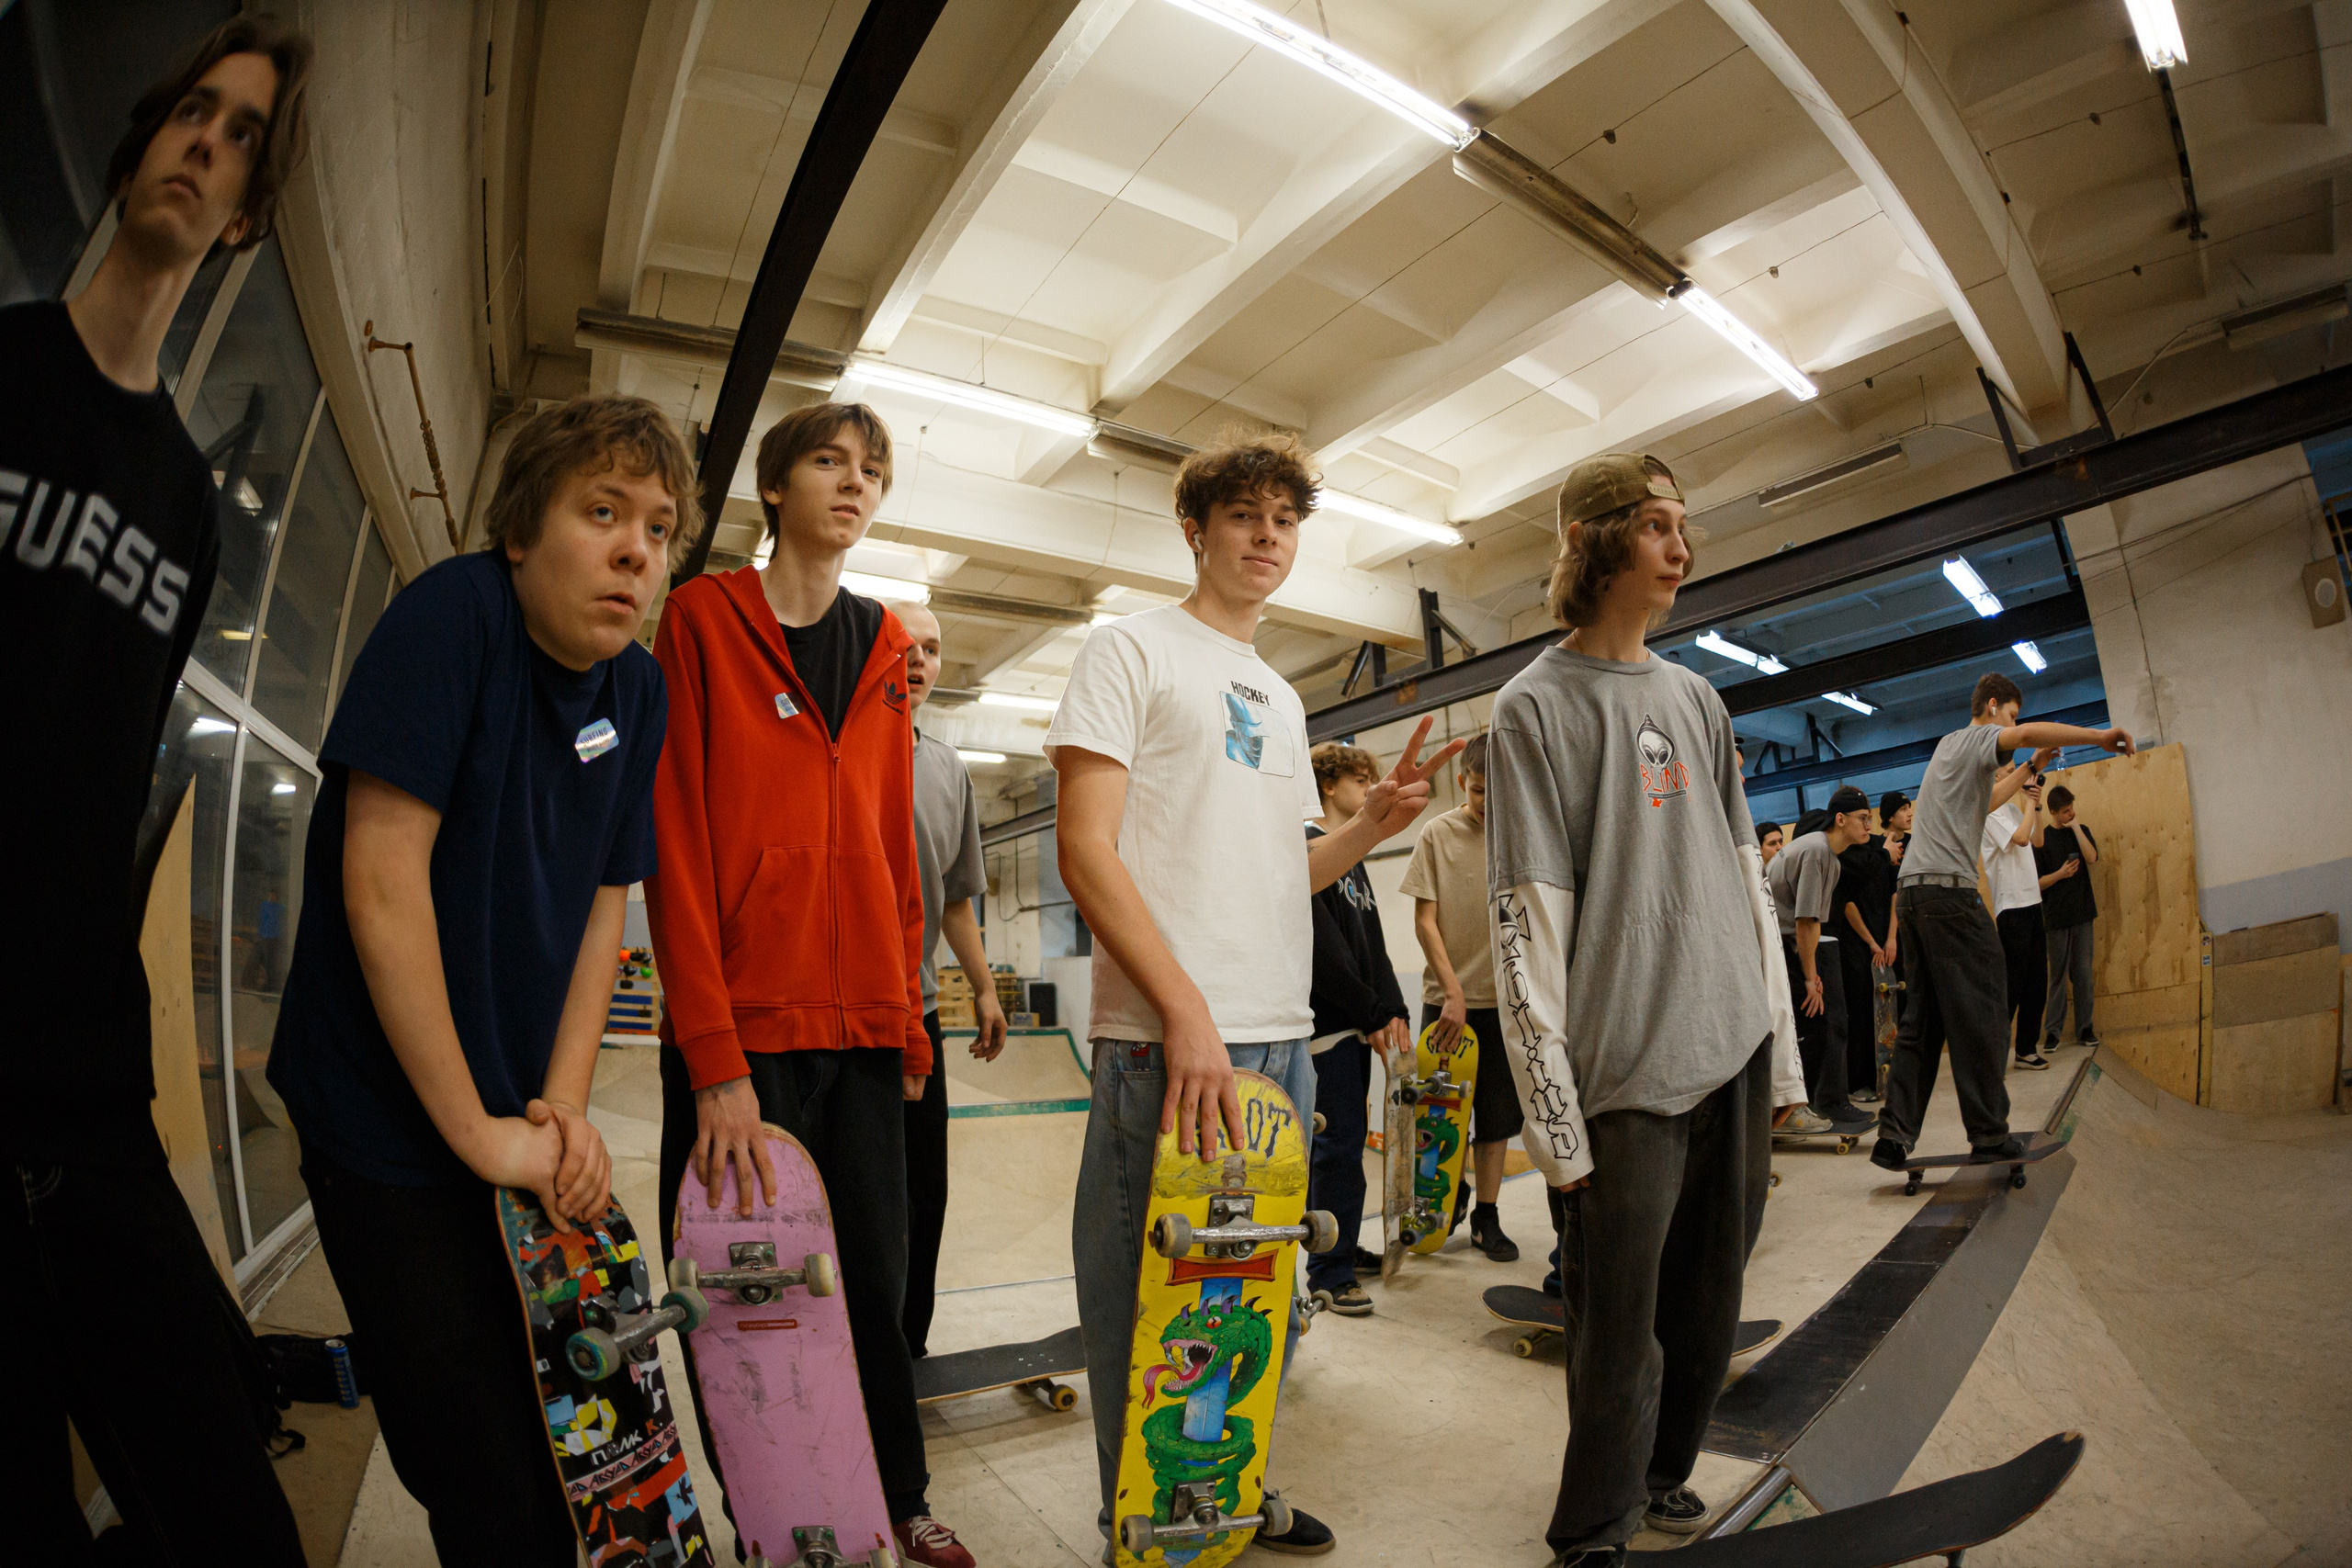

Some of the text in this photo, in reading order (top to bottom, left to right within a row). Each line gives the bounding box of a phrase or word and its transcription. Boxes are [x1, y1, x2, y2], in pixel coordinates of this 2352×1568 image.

[1230, 680, 1271, 706] HOCKEY
[580, 726, 609, 744] SURFING
[1639, 761, 1690, 794] BLIND
